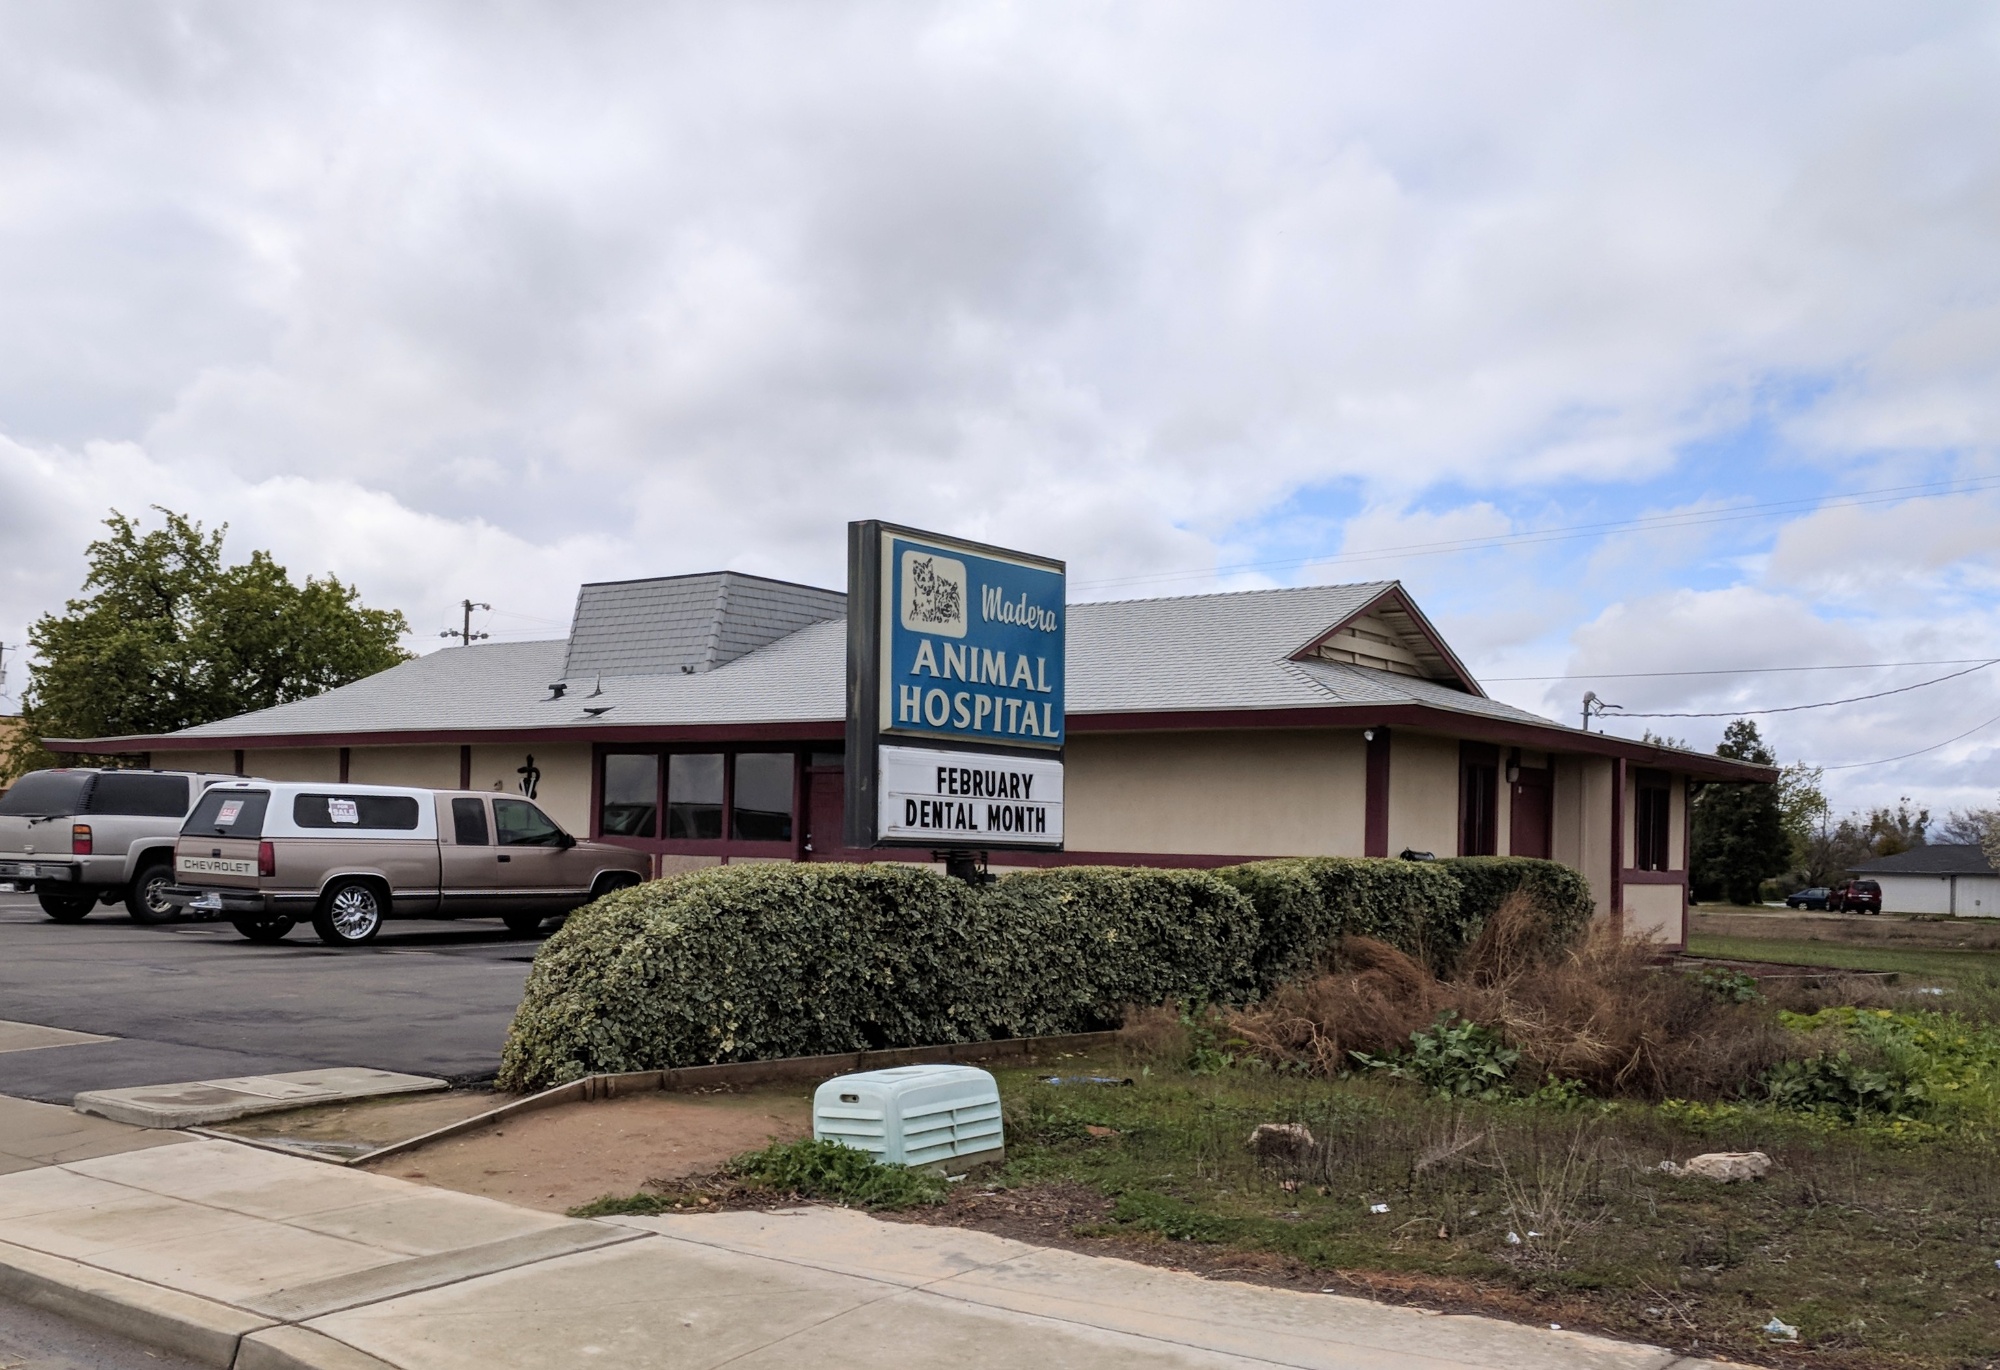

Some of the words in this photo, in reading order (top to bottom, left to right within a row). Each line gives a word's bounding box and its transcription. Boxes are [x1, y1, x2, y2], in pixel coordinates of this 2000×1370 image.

[982, 584, 1057, 632] Madera
[910, 639, 1052, 693] ANIMAL
[899, 684, 1060, 738] HOSPITAL
[937, 766, 1034, 799] FEBRUARY
[905, 799, 978, 830] DENTAL
[987, 804, 1046, 833] MONTH
[184, 860, 250, 872] CHEVROLET
